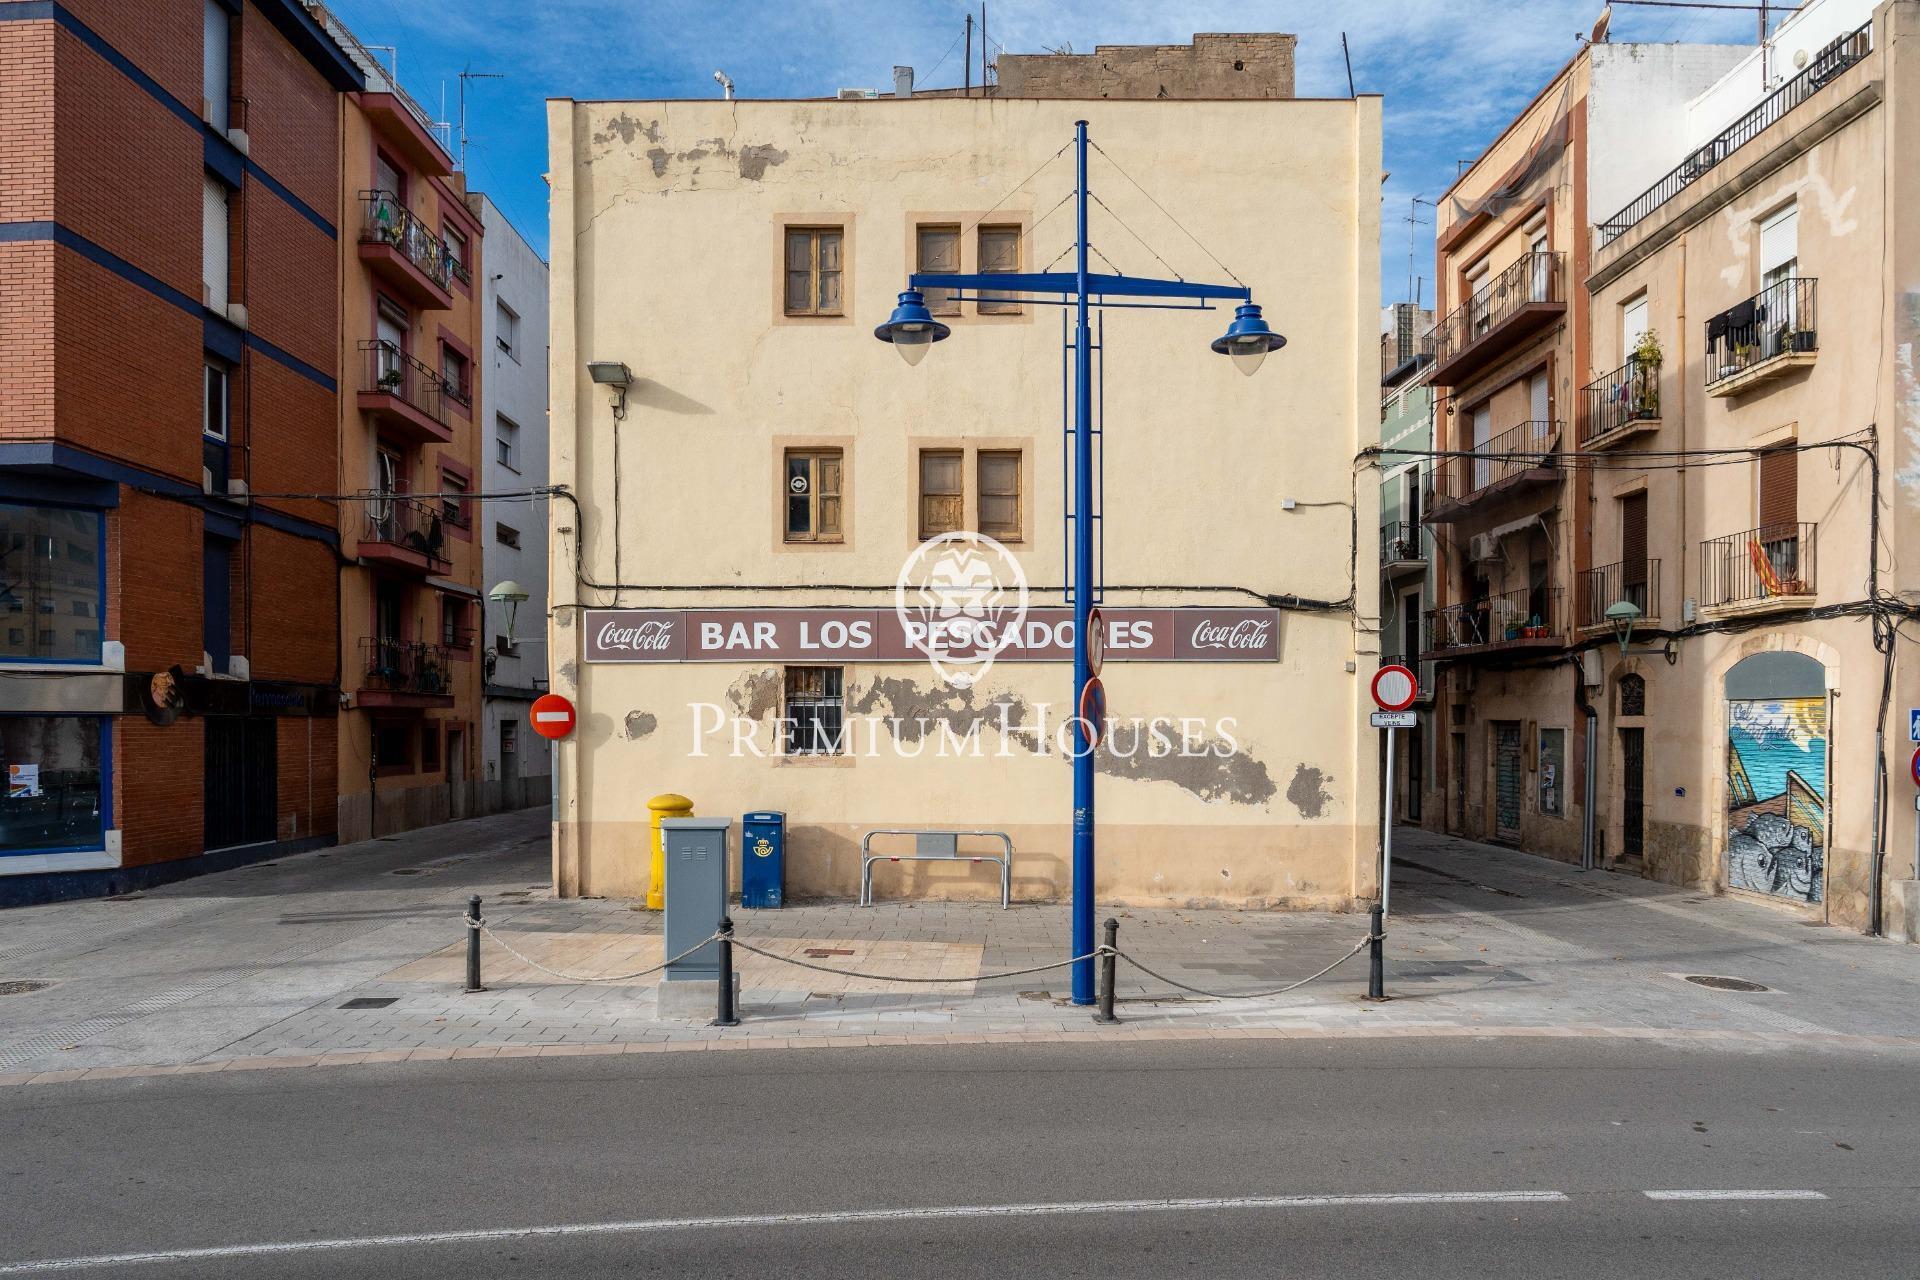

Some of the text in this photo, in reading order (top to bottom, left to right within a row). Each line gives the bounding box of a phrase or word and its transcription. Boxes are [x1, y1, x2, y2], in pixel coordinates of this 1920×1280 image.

[597, 621, 676, 650] Coca-Cola
[701, 620, 1154, 649] BAR LOS PESCADOES
[1192, 620, 1272, 649] Coca-Cola
